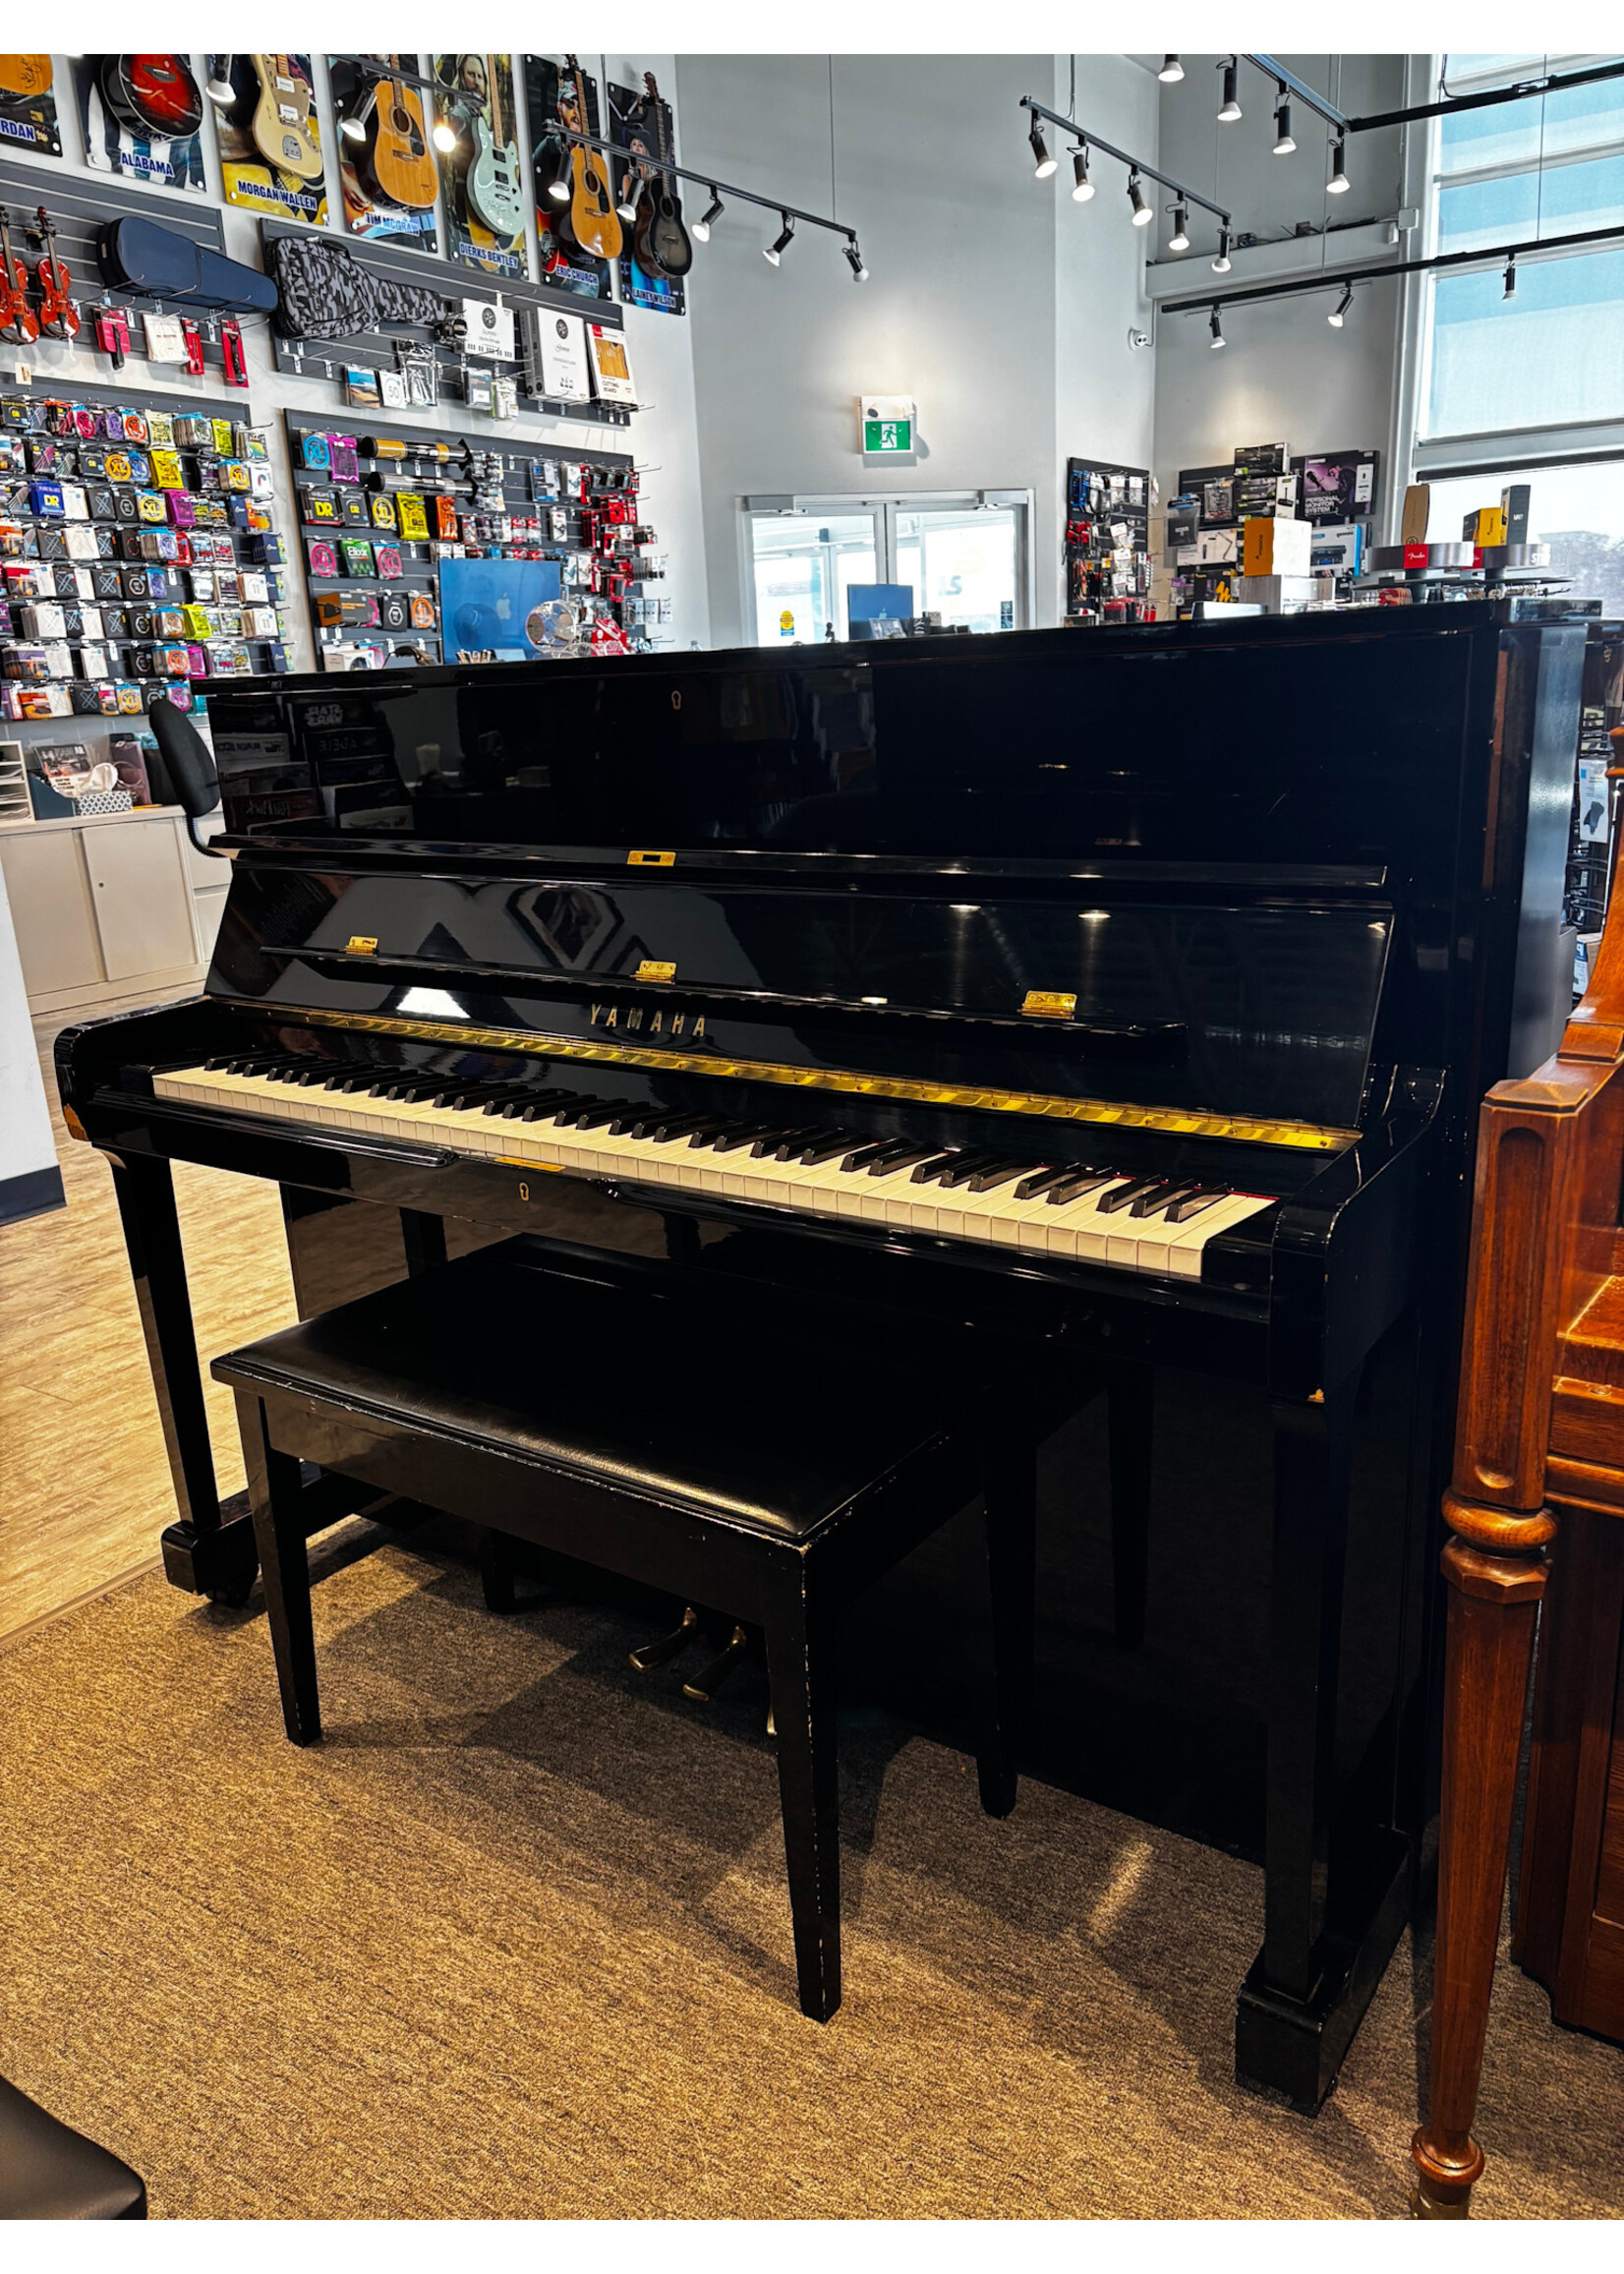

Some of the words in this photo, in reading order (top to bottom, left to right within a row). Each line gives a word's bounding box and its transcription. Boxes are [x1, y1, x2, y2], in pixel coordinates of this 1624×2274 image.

[121, 152, 174, 176] ALABAMA
[237, 180, 279, 202] MORGAN
[280, 191, 317, 209] WALLEN
[365, 211, 381, 225] TIM
[459, 243, 487, 260] DIERKS
[487, 251, 519, 267] BENTLEY
[556, 264, 571, 277] ERIC
[571, 268, 599, 284] CHURCH
[654, 294, 676, 308] WILSON
[44, 495, 59, 507] DR
[315, 501, 334, 517] DR
[590, 1003, 706, 1037] YAMAHA
